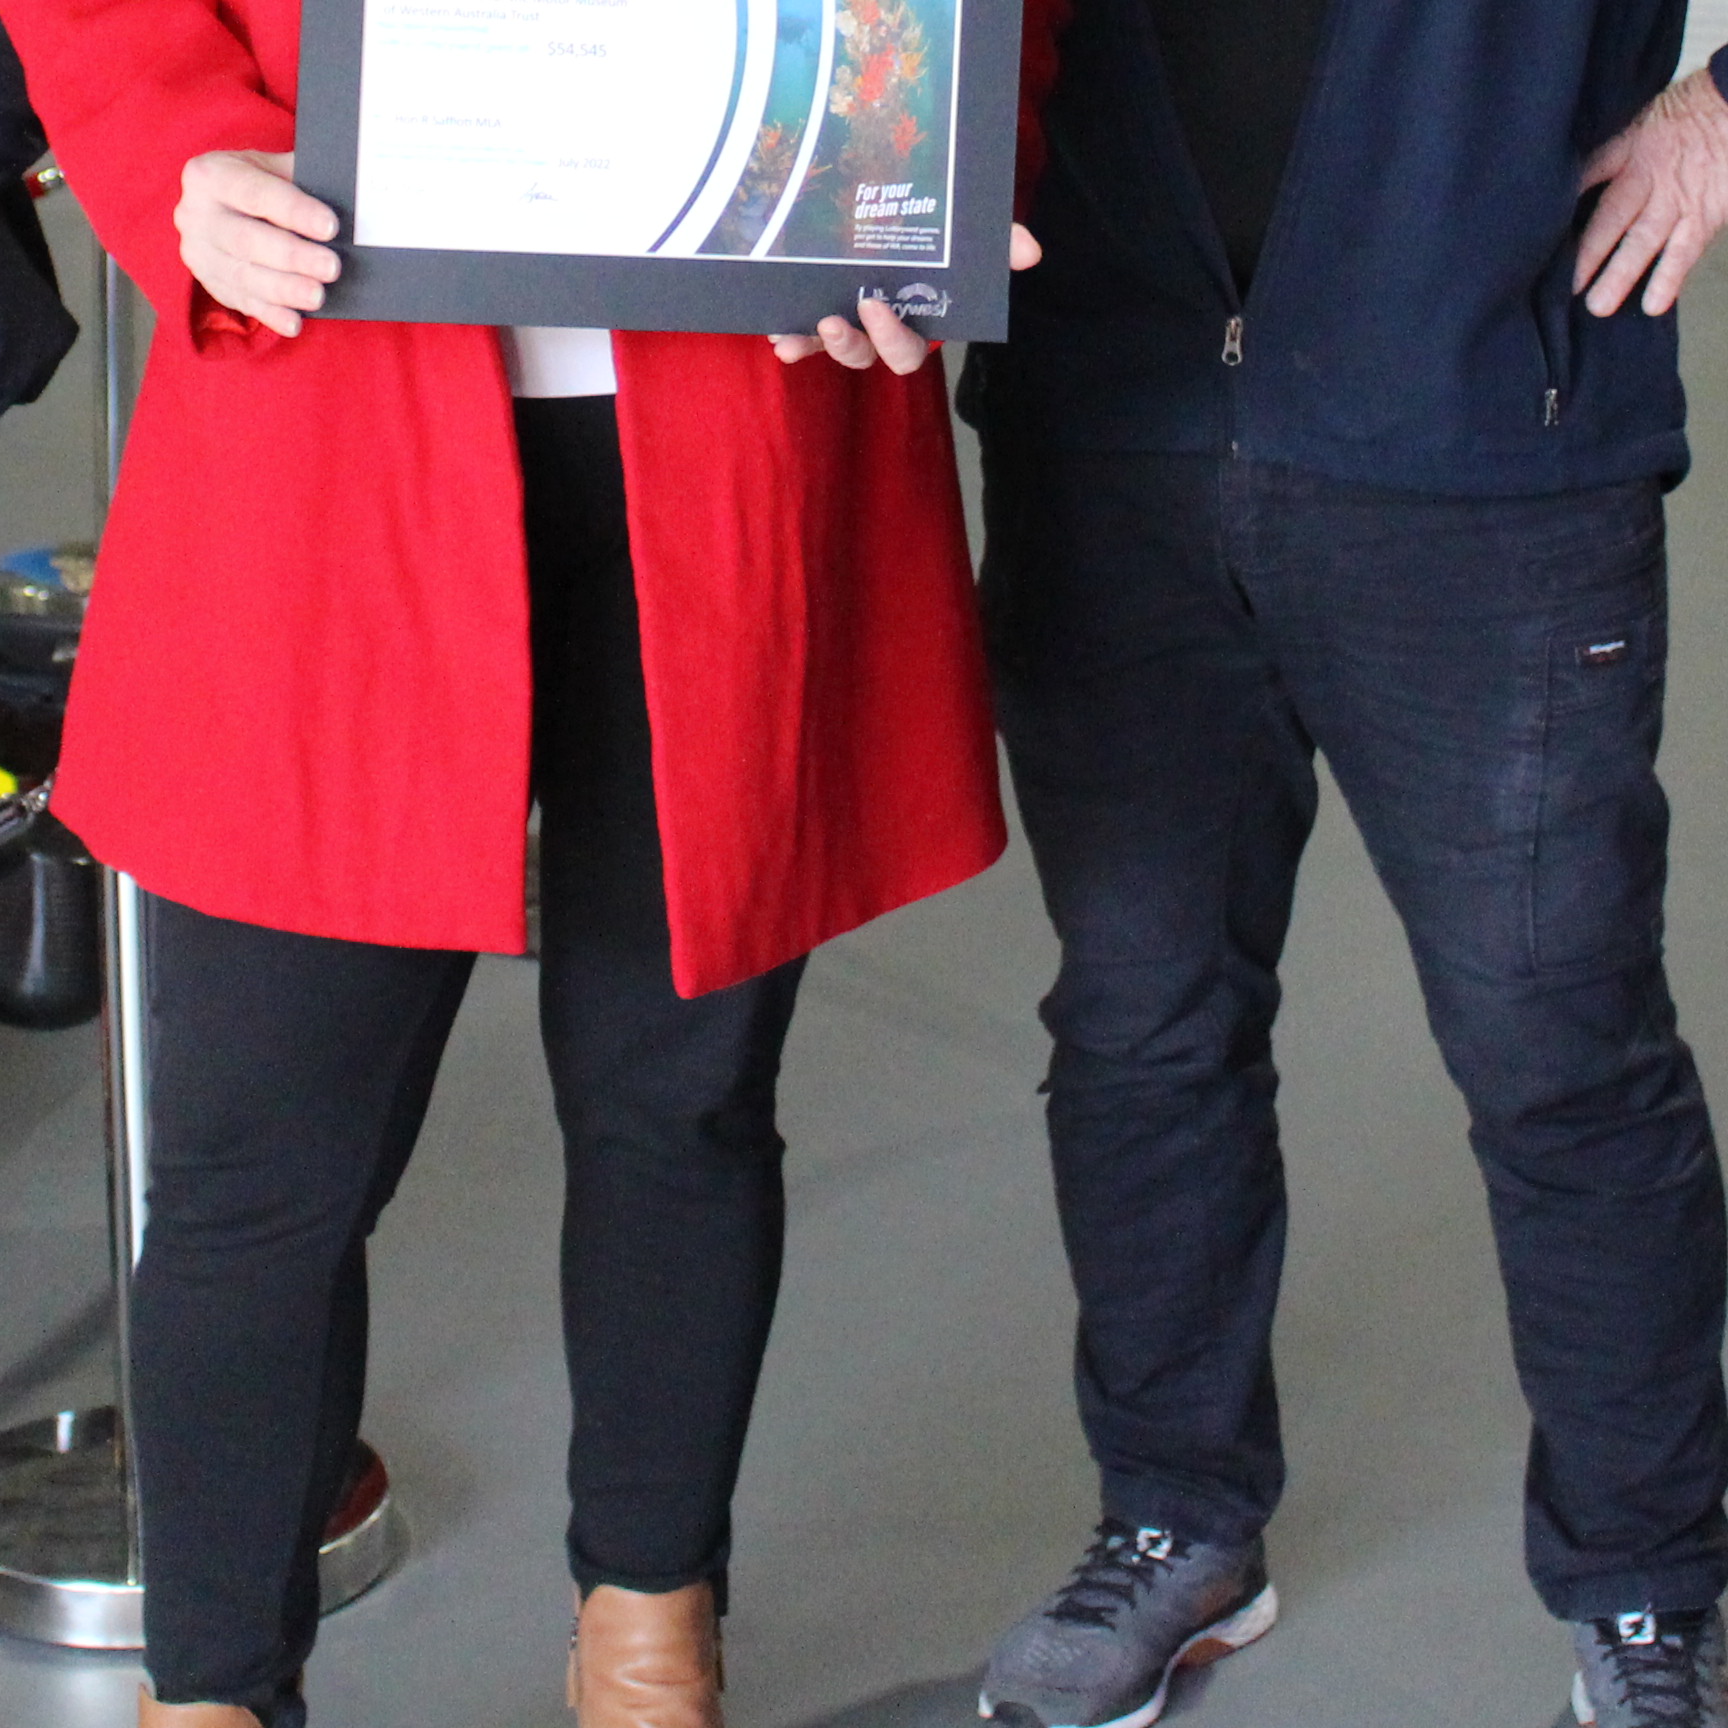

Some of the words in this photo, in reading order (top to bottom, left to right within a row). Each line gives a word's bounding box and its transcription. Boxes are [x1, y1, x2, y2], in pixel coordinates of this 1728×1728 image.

[383, 4, 396, 17] of
[399, 5, 451, 19] Western
[454, 7, 507, 21] Australia
[510, 9, 541, 22] Trust
[547, 41, 608, 59] $54,545
[557, 156, 579, 171] July
[582, 157, 611, 171] 2022
[855, 183, 880, 202] For
[879, 182, 914, 203] your
[854, 201, 899, 220] dream
[900, 196, 937, 216] state
